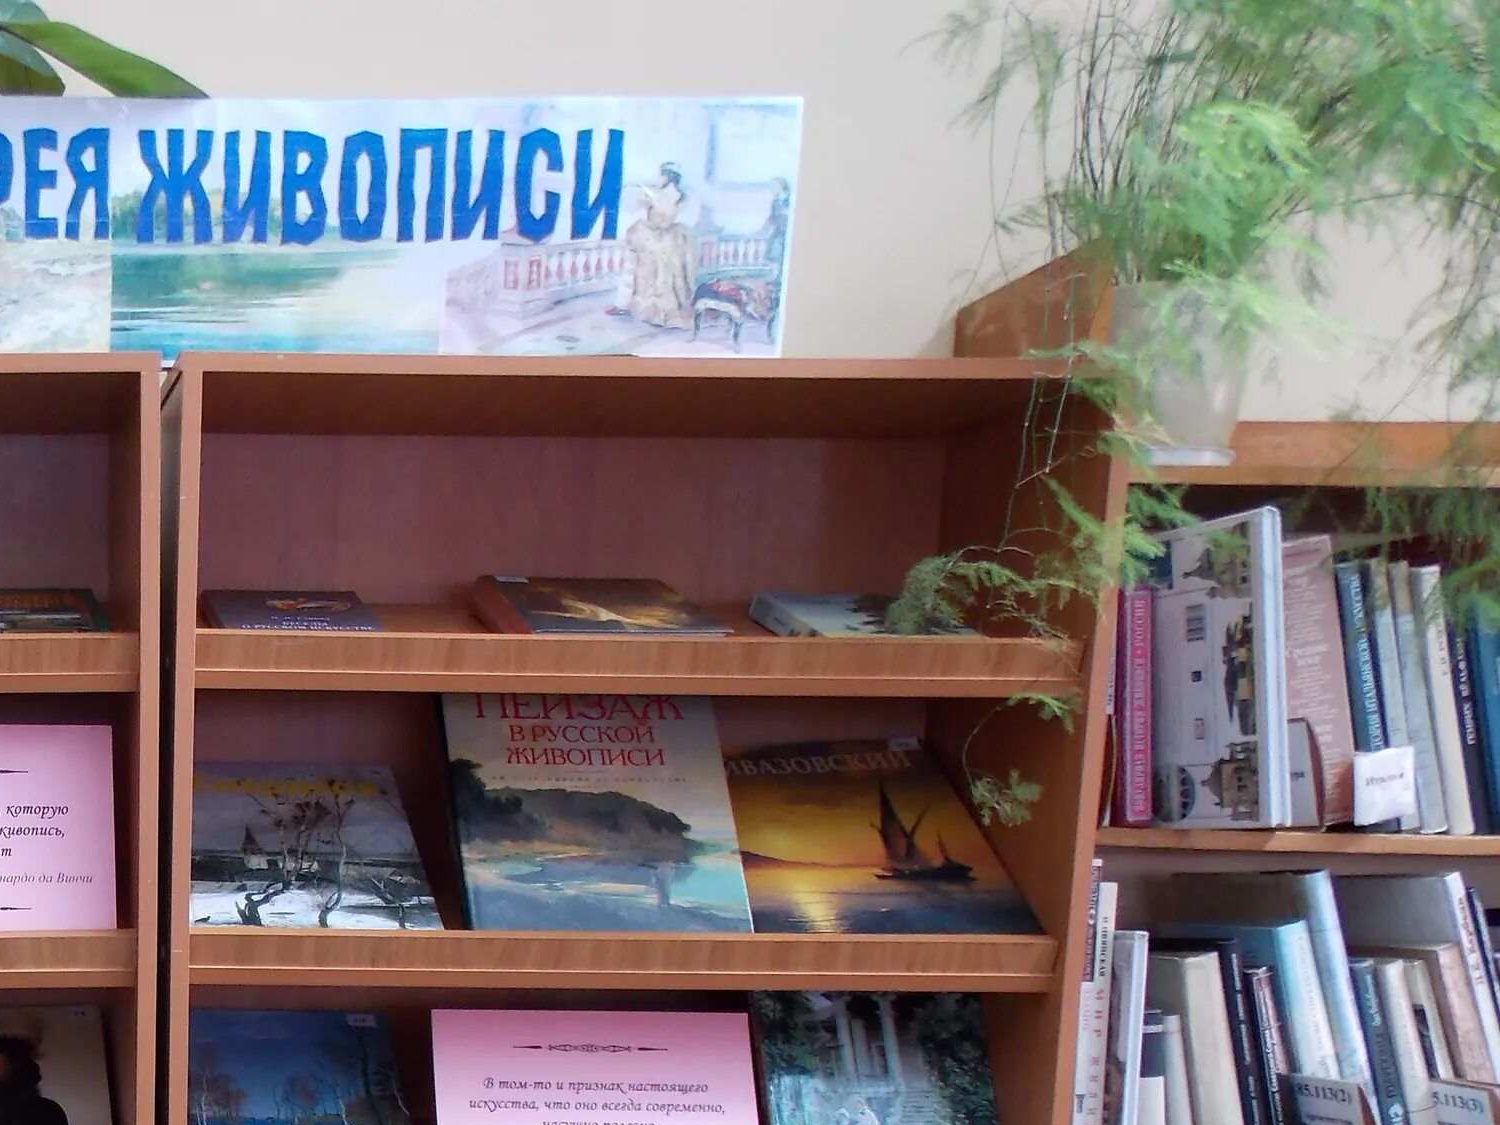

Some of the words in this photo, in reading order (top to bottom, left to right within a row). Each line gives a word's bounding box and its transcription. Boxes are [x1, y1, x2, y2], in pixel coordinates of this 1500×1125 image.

[137, 128, 625, 244] ЖИВОПИСИ
[509, 725, 525, 742] В
[532, 724, 656, 743] РУССКОЙ
[506, 748, 665, 766] ЖИВОПИСИ
[724, 751, 911, 777] ВАЗОВСКИЙ
[6, 804, 69, 819] которую
[38, 872, 54, 883] да
[56, 872, 93, 883] Винчи
[483, 1077, 495, 1089] В
[498, 1079, 553, 1090] том-то
[556, 1082, 565, 1090] и
[568, 1080, 626, 1095] признак
[627, 1082, 709, 1094] настоящего
[469, 1099, 539, 1112] искусства,
[544, 1100, 571, 1111] что
[574, 1101, 598, 1111] оно
[601, 1099, 643, 1112] всегда
[646, 1101, 726, 1116] современно,
